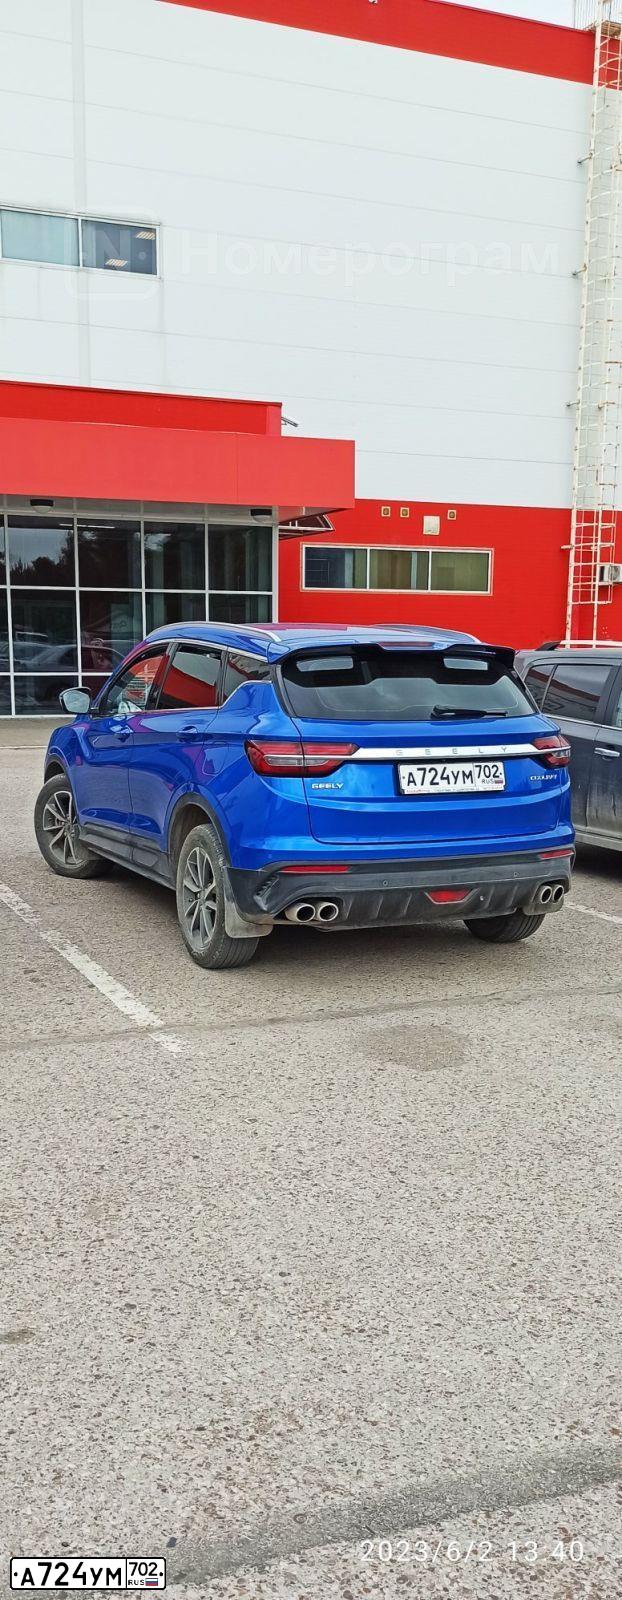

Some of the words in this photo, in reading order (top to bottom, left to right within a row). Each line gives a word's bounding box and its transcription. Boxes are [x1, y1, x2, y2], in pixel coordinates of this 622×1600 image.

[396, 746, 507, 757] GEELY
[407, 767, 474, 786] А724УМ
[475, 764, 500, 779] 702
